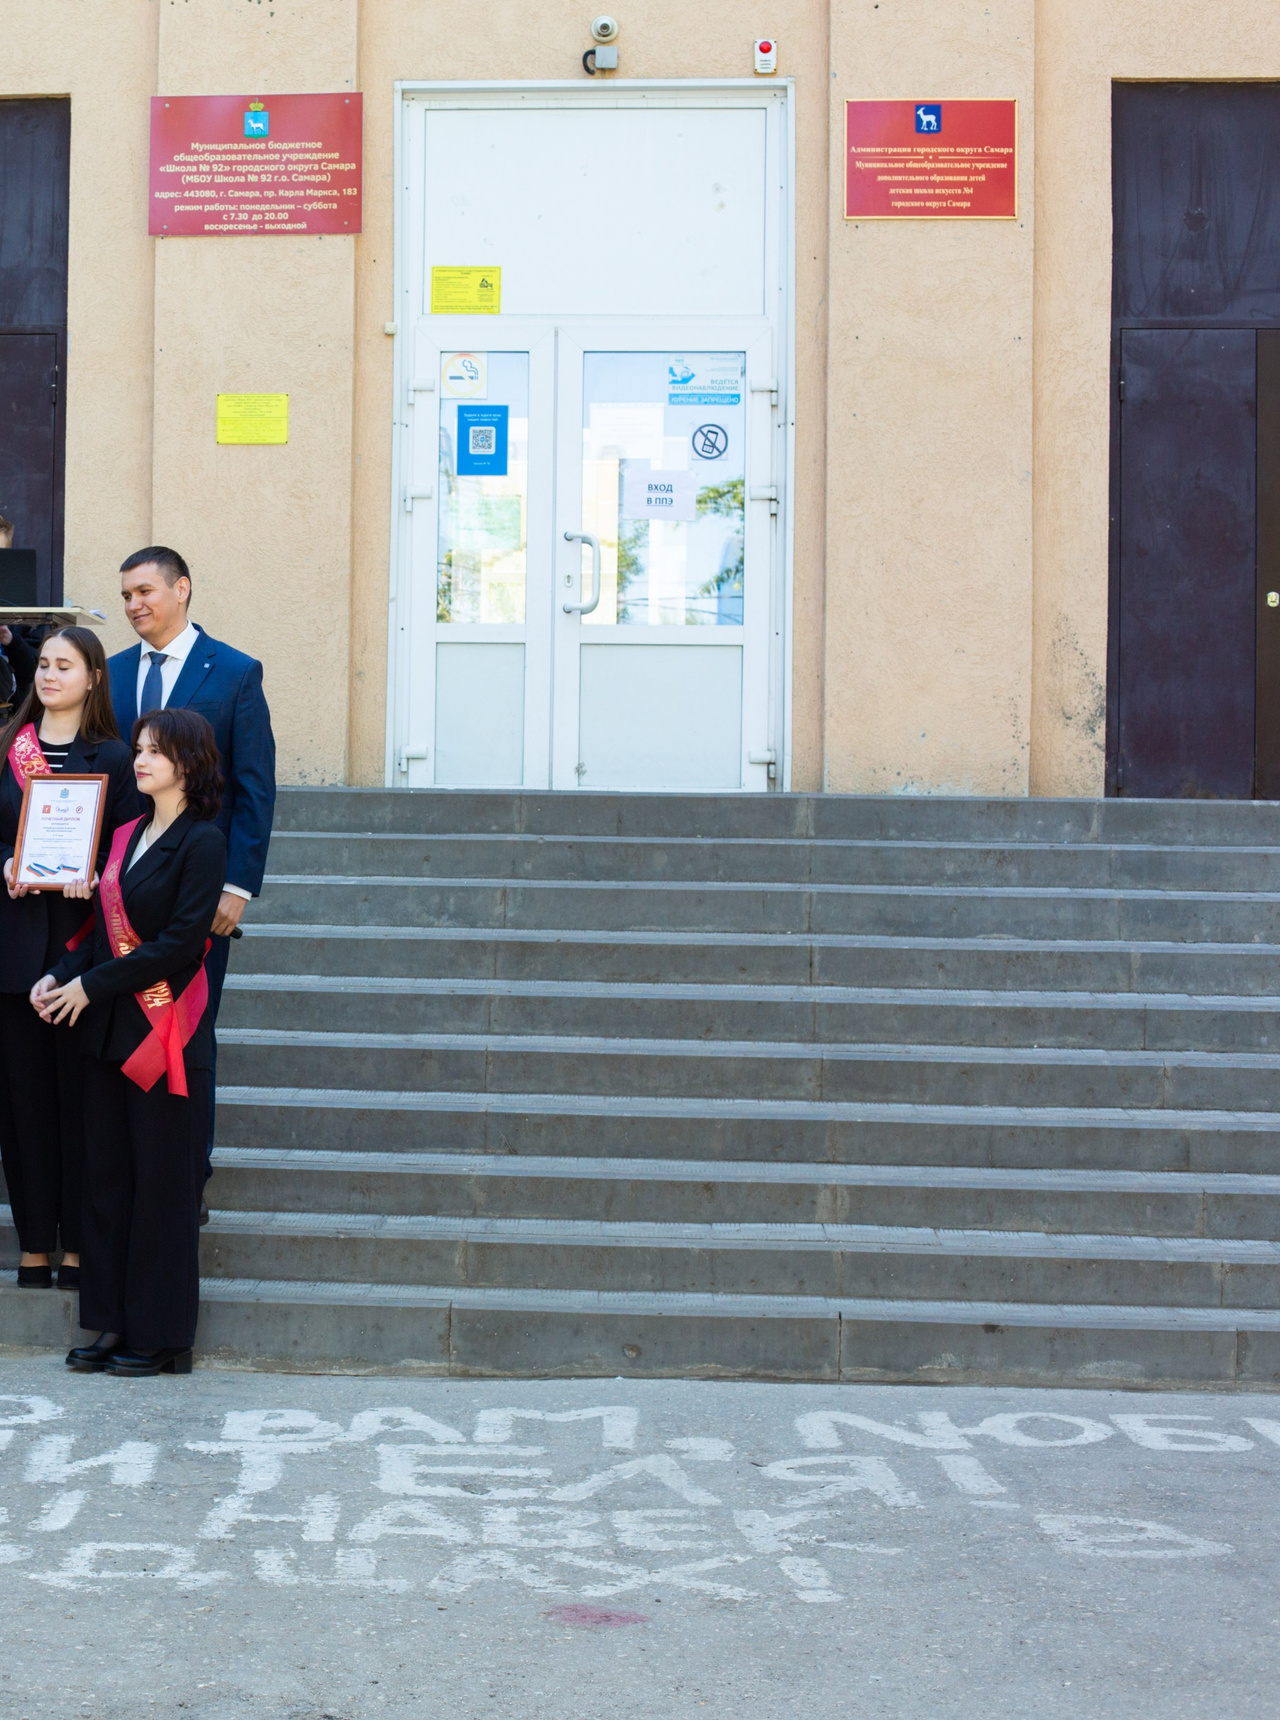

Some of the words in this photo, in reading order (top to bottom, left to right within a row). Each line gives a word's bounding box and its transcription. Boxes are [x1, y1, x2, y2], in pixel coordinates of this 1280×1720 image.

[191, 142, 266, 151] Муниципальное
[268, 141, 322, 150] бюджетное
[174, 153, 280, 162] общеобразовательное
[282, 152, 339, 161] учреждение
[159, 165, 197, 173] «Школа
[199, 164, 210, 172] №
[212, 164, 230, 172] 92»
[233, 164, 285, 173] городского
[287, 163, 319, 172] округа
[321, 163, 356, 172] Самара
[182, 175, 212, 185] (МБОУ
[214, 175, 245, 183] Школа
[247, 174, 258, 182] №
[261, 174, 272, 182] 92
[292, 173, 331, 183] Самара)
[155, 191, 182, 199] адрес:
[184, 190, 218, 199] 443080,
[228, 190, 262, 198] Самара,
[279, 189, 304, 198] Карла
[306, 189, 340, 197] Маркса,
[175, 204, 203, 212] режим
[204, 203, 238, 212] работы:
[240, 203, 295, 211] понедельник
[303, 202, 337, 211] суббота
[204, 223, 258, 231] воскресенье
[265, 222, 307, 230] выходной
[648, 484, 673, 493] ВХОД
[142, 981, 172, 1009] 024
